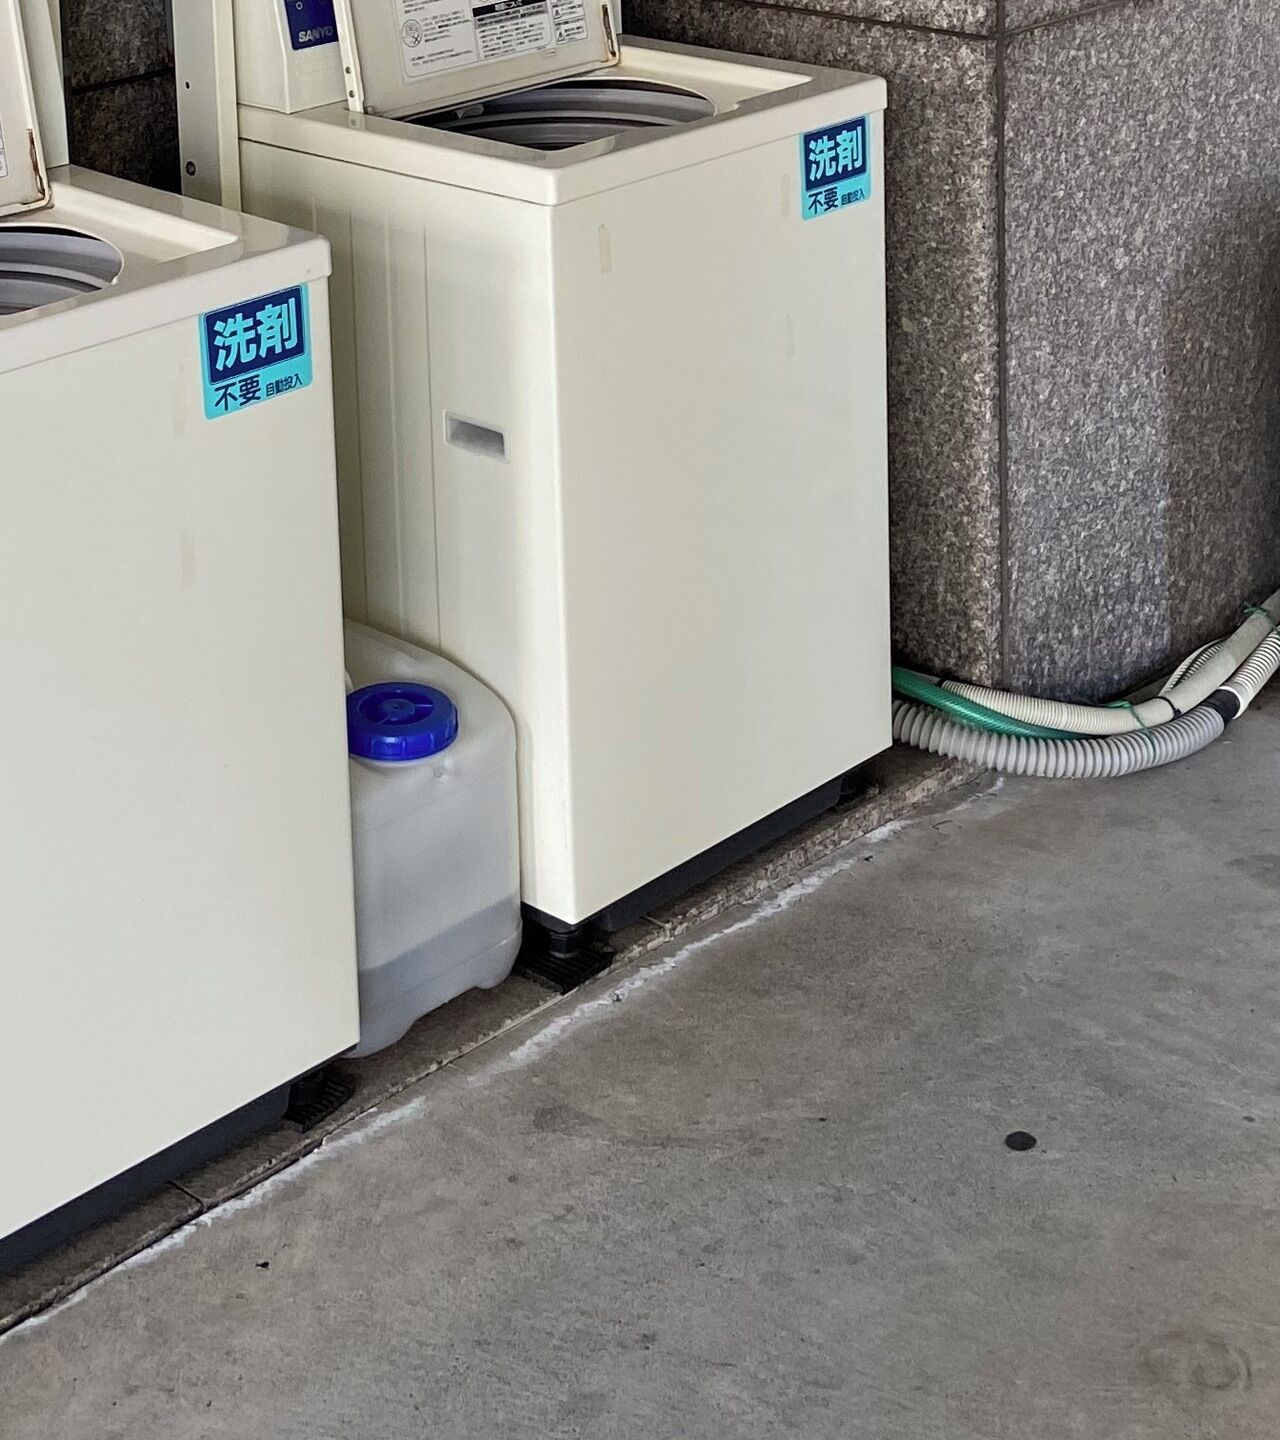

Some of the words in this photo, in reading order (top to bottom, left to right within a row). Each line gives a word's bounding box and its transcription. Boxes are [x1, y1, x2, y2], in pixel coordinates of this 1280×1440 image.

[298, 25, 333, 43] SANYO
[808, 126, 862, 181] 洗剤
[808, 187, 839, 215] 不要
[214, 297, 298, 372] 洗剤
[214, 374, 261, 411] 不要
[266, 373, 303, 397] 自動投入
